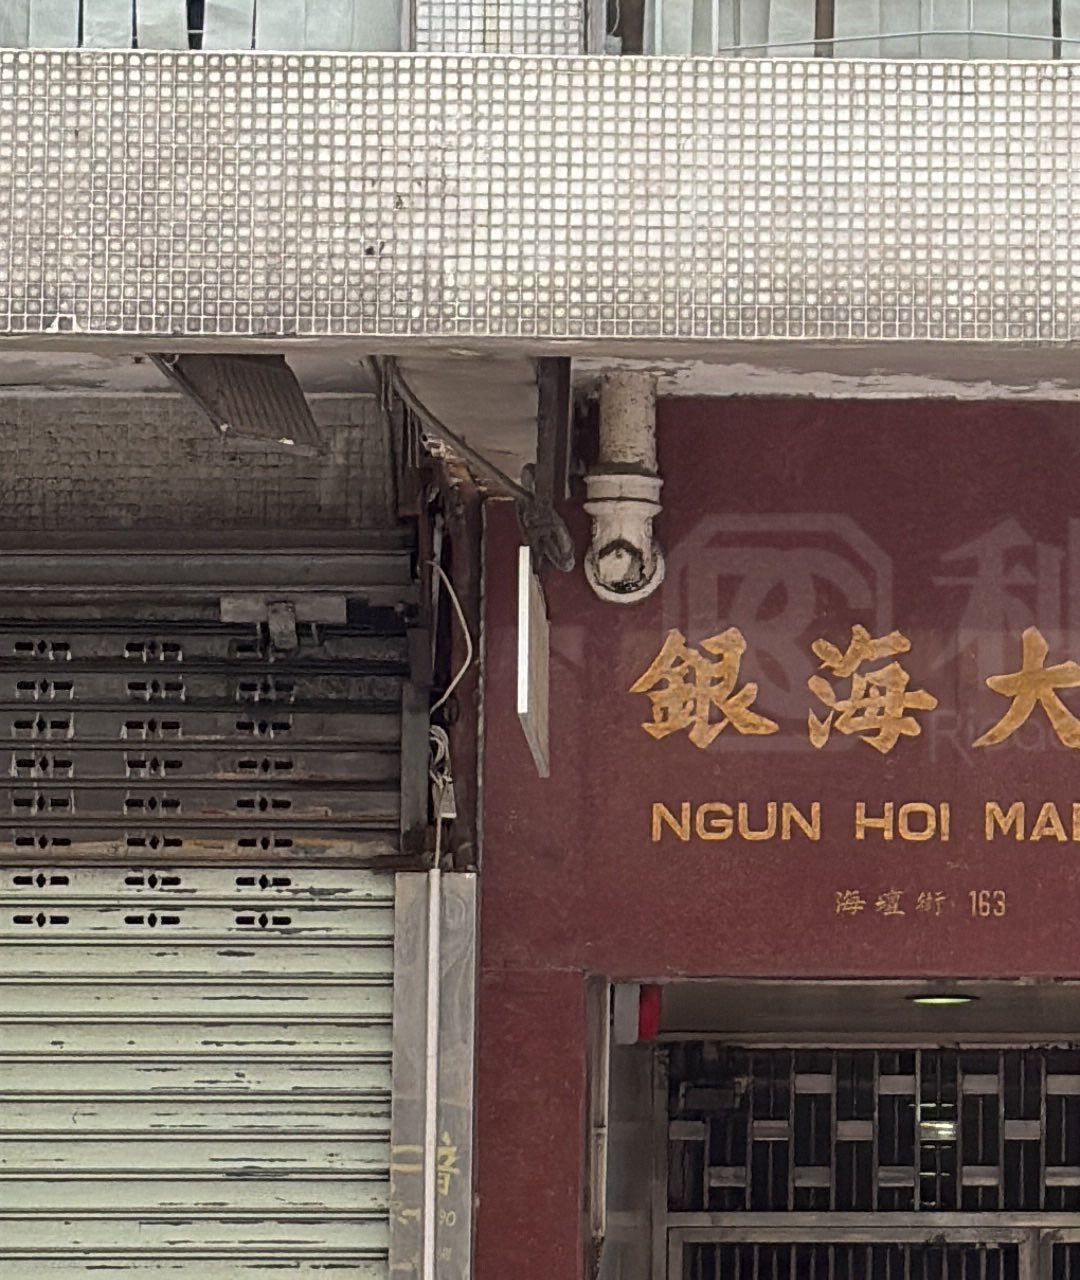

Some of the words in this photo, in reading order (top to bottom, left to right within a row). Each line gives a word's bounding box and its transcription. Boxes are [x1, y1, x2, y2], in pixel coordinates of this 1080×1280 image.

[650, 801, 822, 842] NGUN
[854, 802, 951, 842] HOI
[834, 888, 947, 917] 海壇街
[967, 889, 1007, 917] 163
